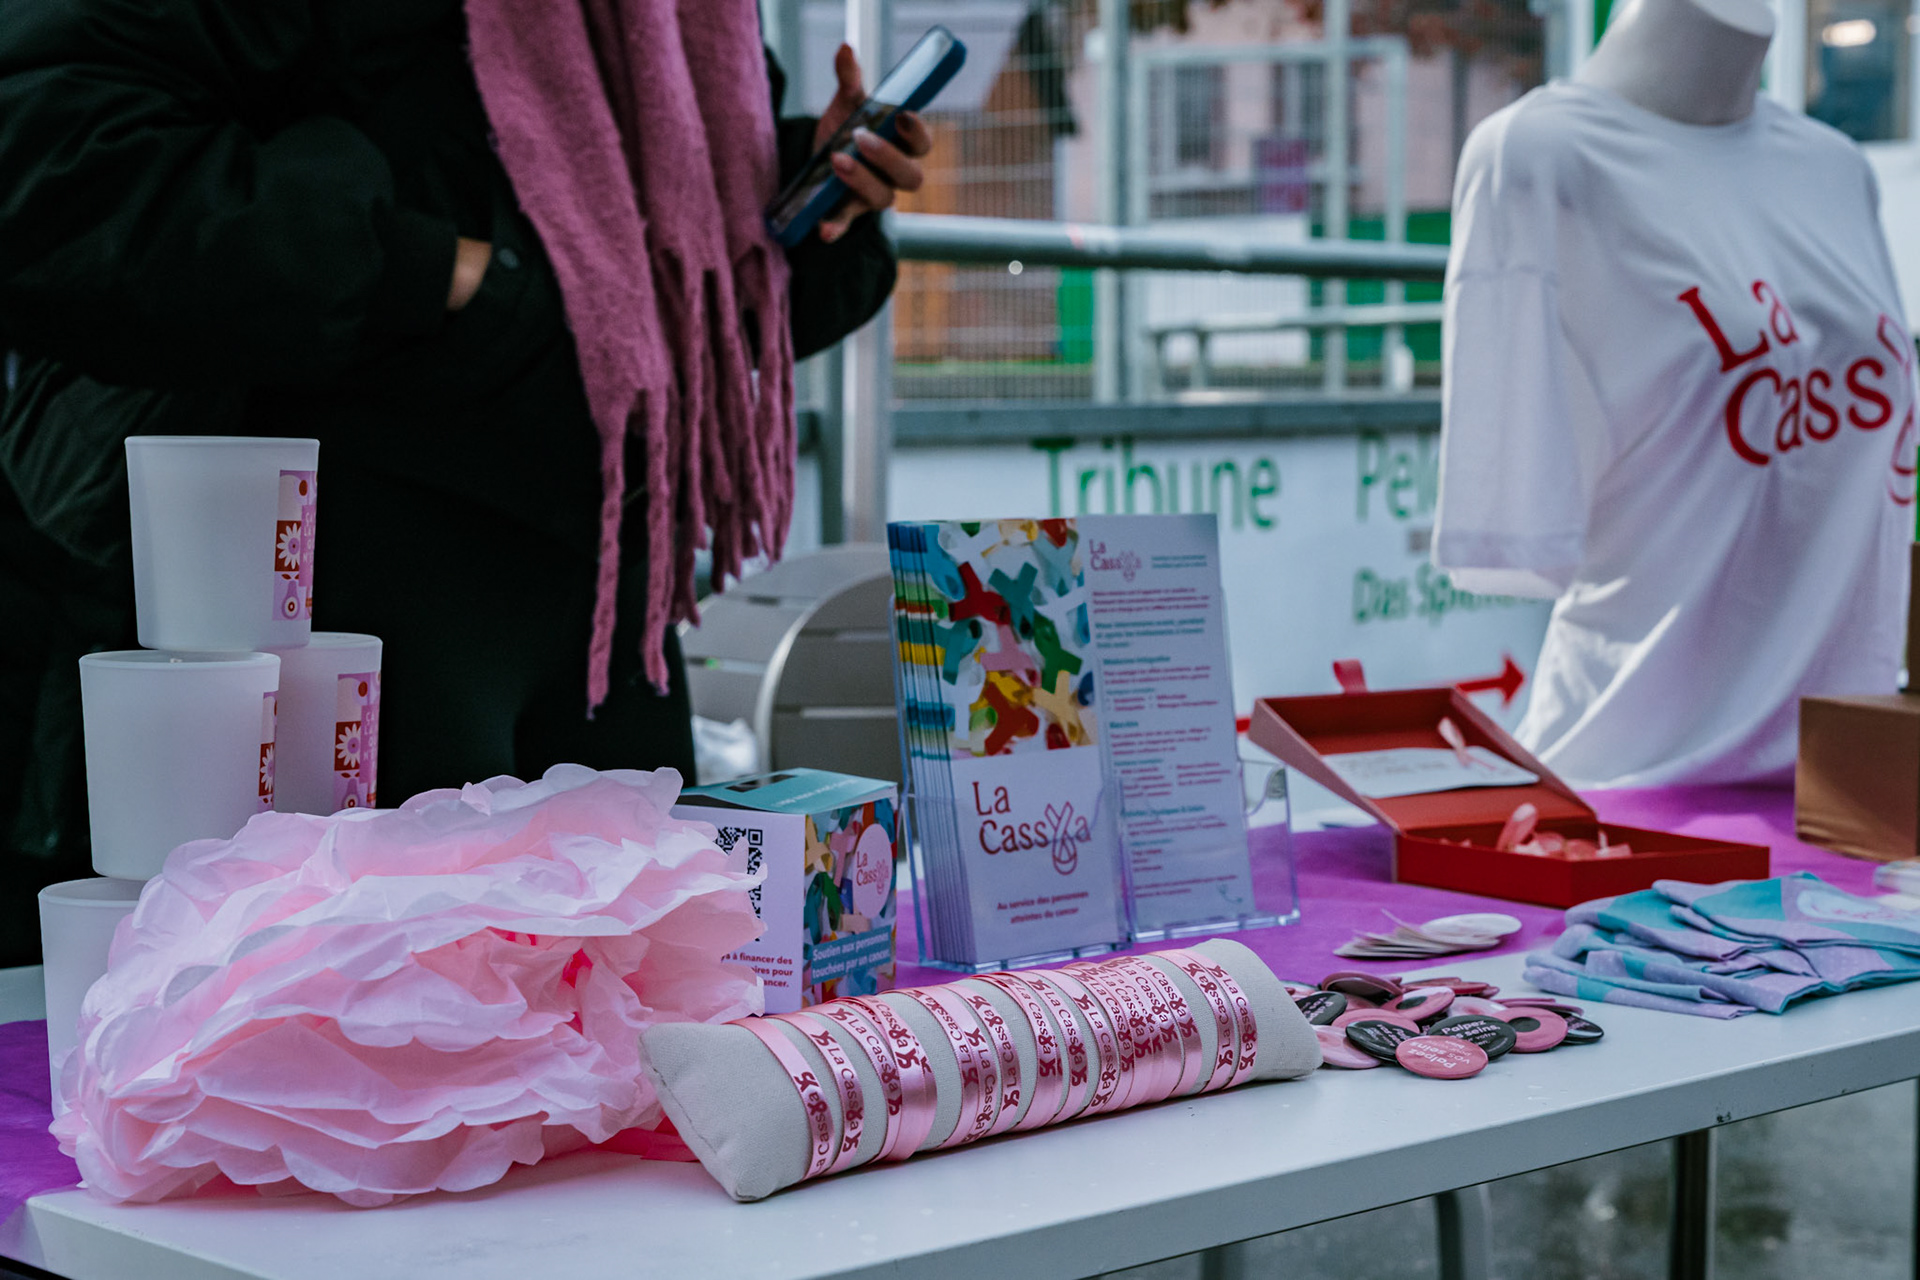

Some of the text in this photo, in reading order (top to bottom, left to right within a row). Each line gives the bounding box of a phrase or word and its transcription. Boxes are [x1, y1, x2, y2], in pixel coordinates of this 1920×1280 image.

[1677, 279, 1800, 373] La
[1031, 435, 1280, 531] Tribune
[972, 781, 1011, 816] La
[857, 851, 868, 868] La
[812, 932, 889, 961] Soutien aux personnes
[732, 952, 738, 960] à
[739, 952, 774, 964] financer
[777, 956, 793, 965] des
[812, 962, 845, 978] touchées
[846, 958, 858, 973] par
[859, 956, 867, 966] un
[1135, 961, 1153, 972] La
[772, 969, 793, 977] pour
[1120, 965, 1137, 977] La
[763, 980, 790, 988] ancer.
[1090, 982, 1106, 996] La
[1099, 975, 1116, 988] La
[1223, 978, 1239, 994] La
[1044, 991, 1061, 1007] La
[847, 1019, 867, 1034] La
[1088, 1011, 1103, 1029] La
[1441, 1020, 1486, 1034] Palpez
[1222, 1028, 1231, 1049] La
[827, 1046, 845, 1065] La
[960, 1044, 972, 1064] La
[978, 1049, 990, 1070] La
[1408, 1048, 1457, 1069] Palpez
[1410, 1041, 1470, 1065] vos seins
[1007, 1070, 1018, 1089] La
